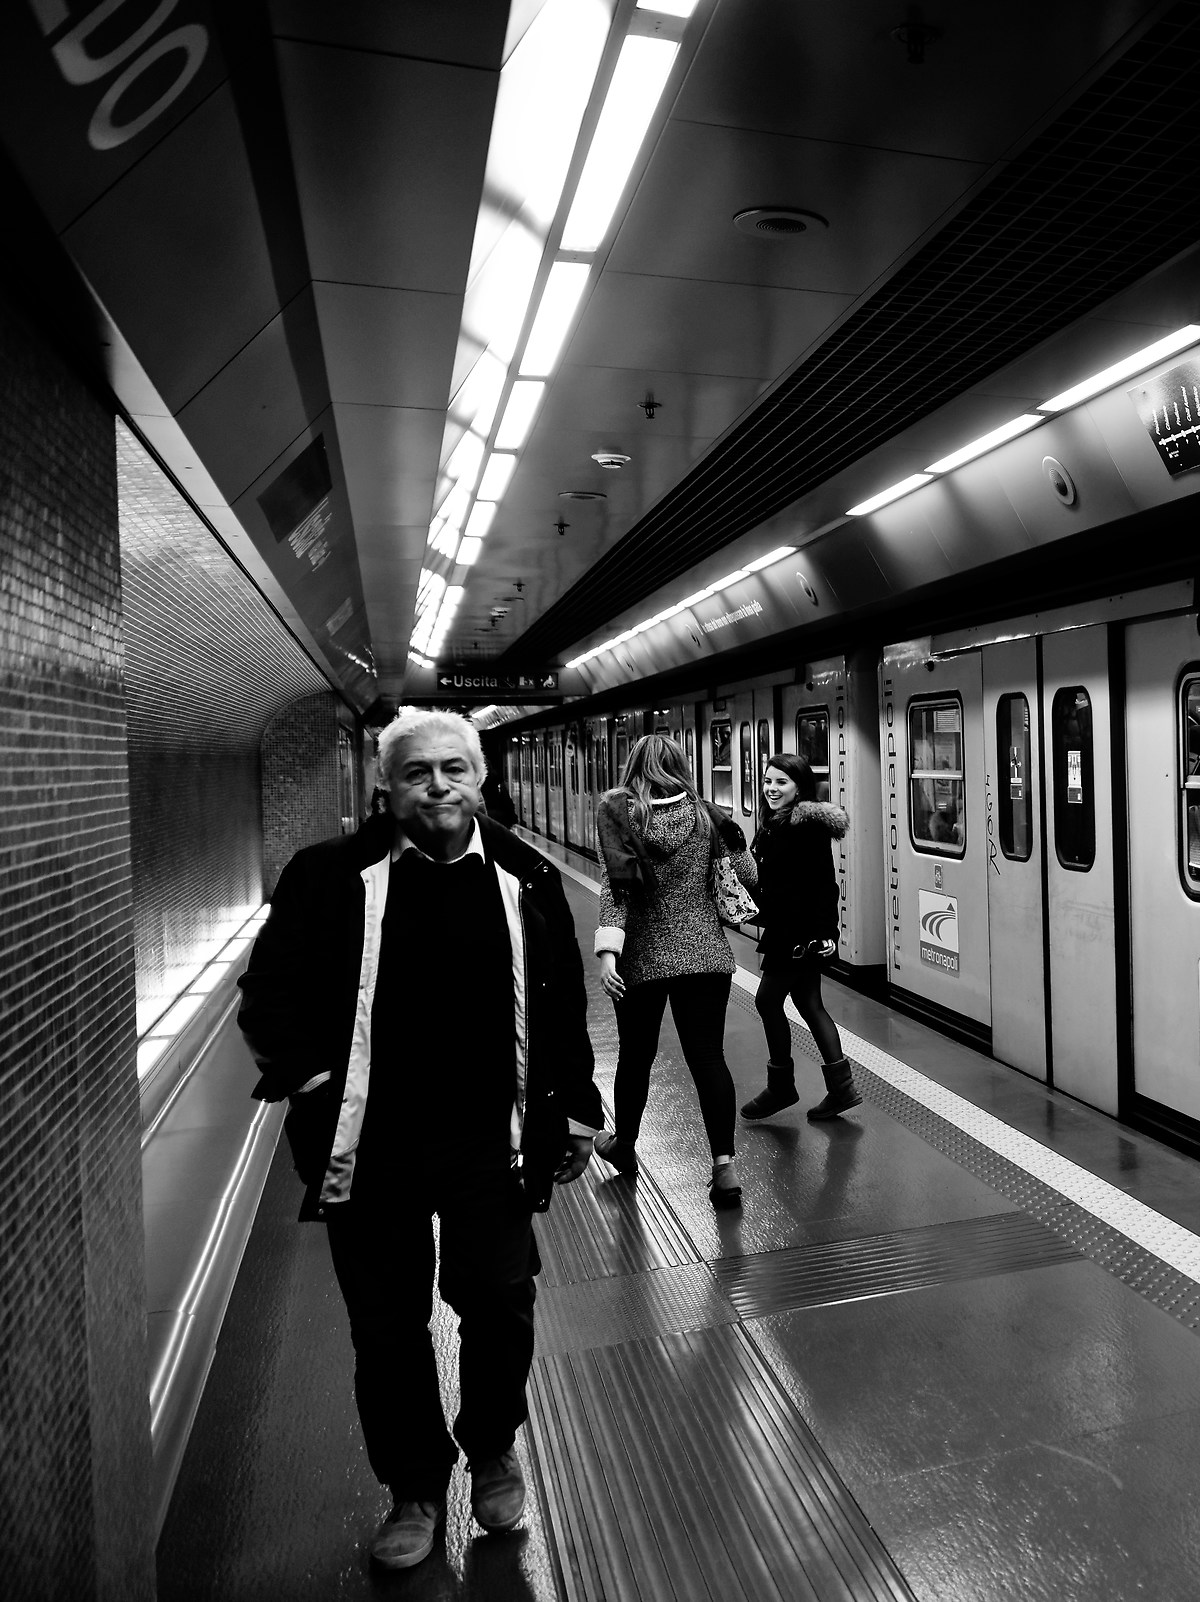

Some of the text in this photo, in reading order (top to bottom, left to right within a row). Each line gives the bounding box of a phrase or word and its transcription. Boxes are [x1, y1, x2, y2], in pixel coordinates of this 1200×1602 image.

[25, 0, 210, 150] DO
[453, 675, 498, 688] Uscita
[836, 685, 848, 947] metrnapoli
[884, 679, 900, 970] metronapoli
[921, 947, 958, 971] metronapoli
